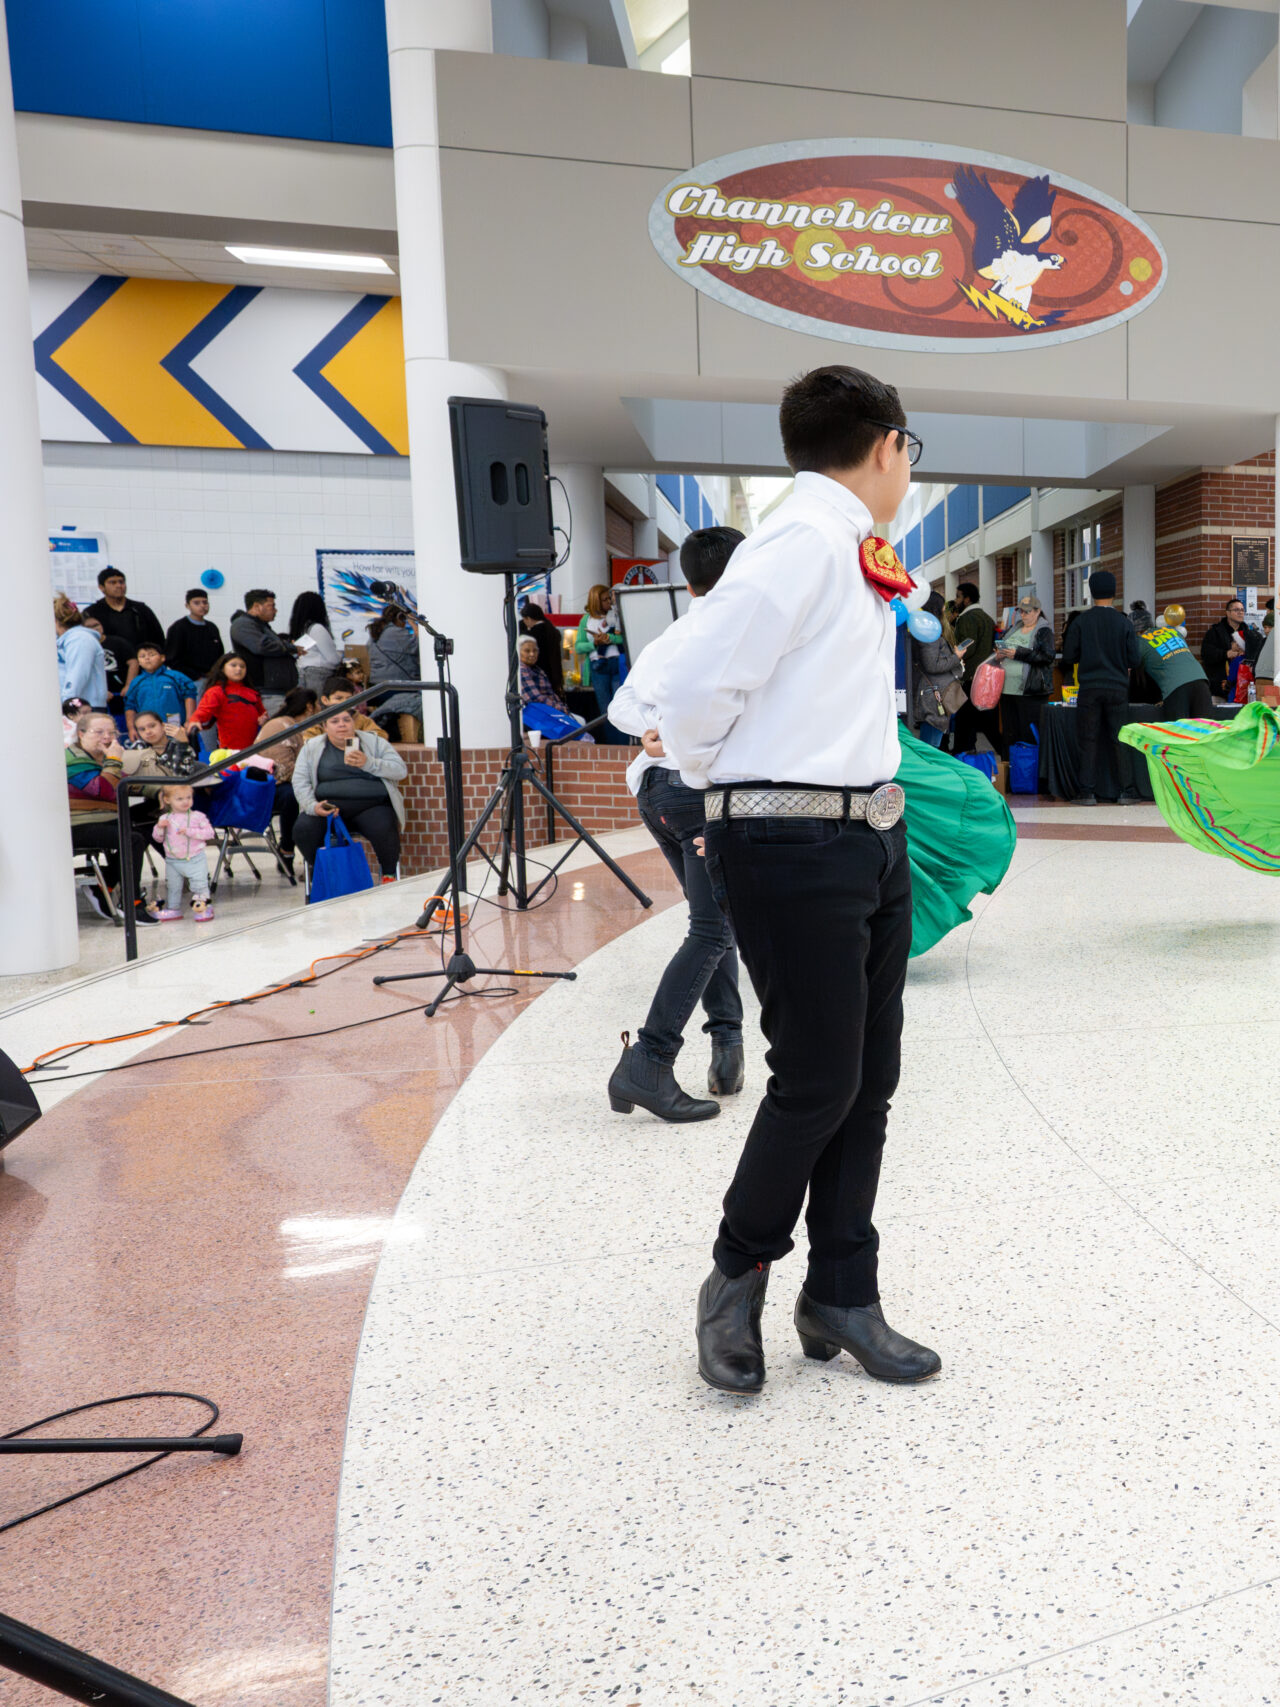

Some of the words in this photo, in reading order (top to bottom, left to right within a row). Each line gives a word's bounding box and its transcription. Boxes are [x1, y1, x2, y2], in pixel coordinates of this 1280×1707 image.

[666, 184, 951, 235] Channelview
[679, 233, 793, 272] High
[803, 241, 944, 278] School
